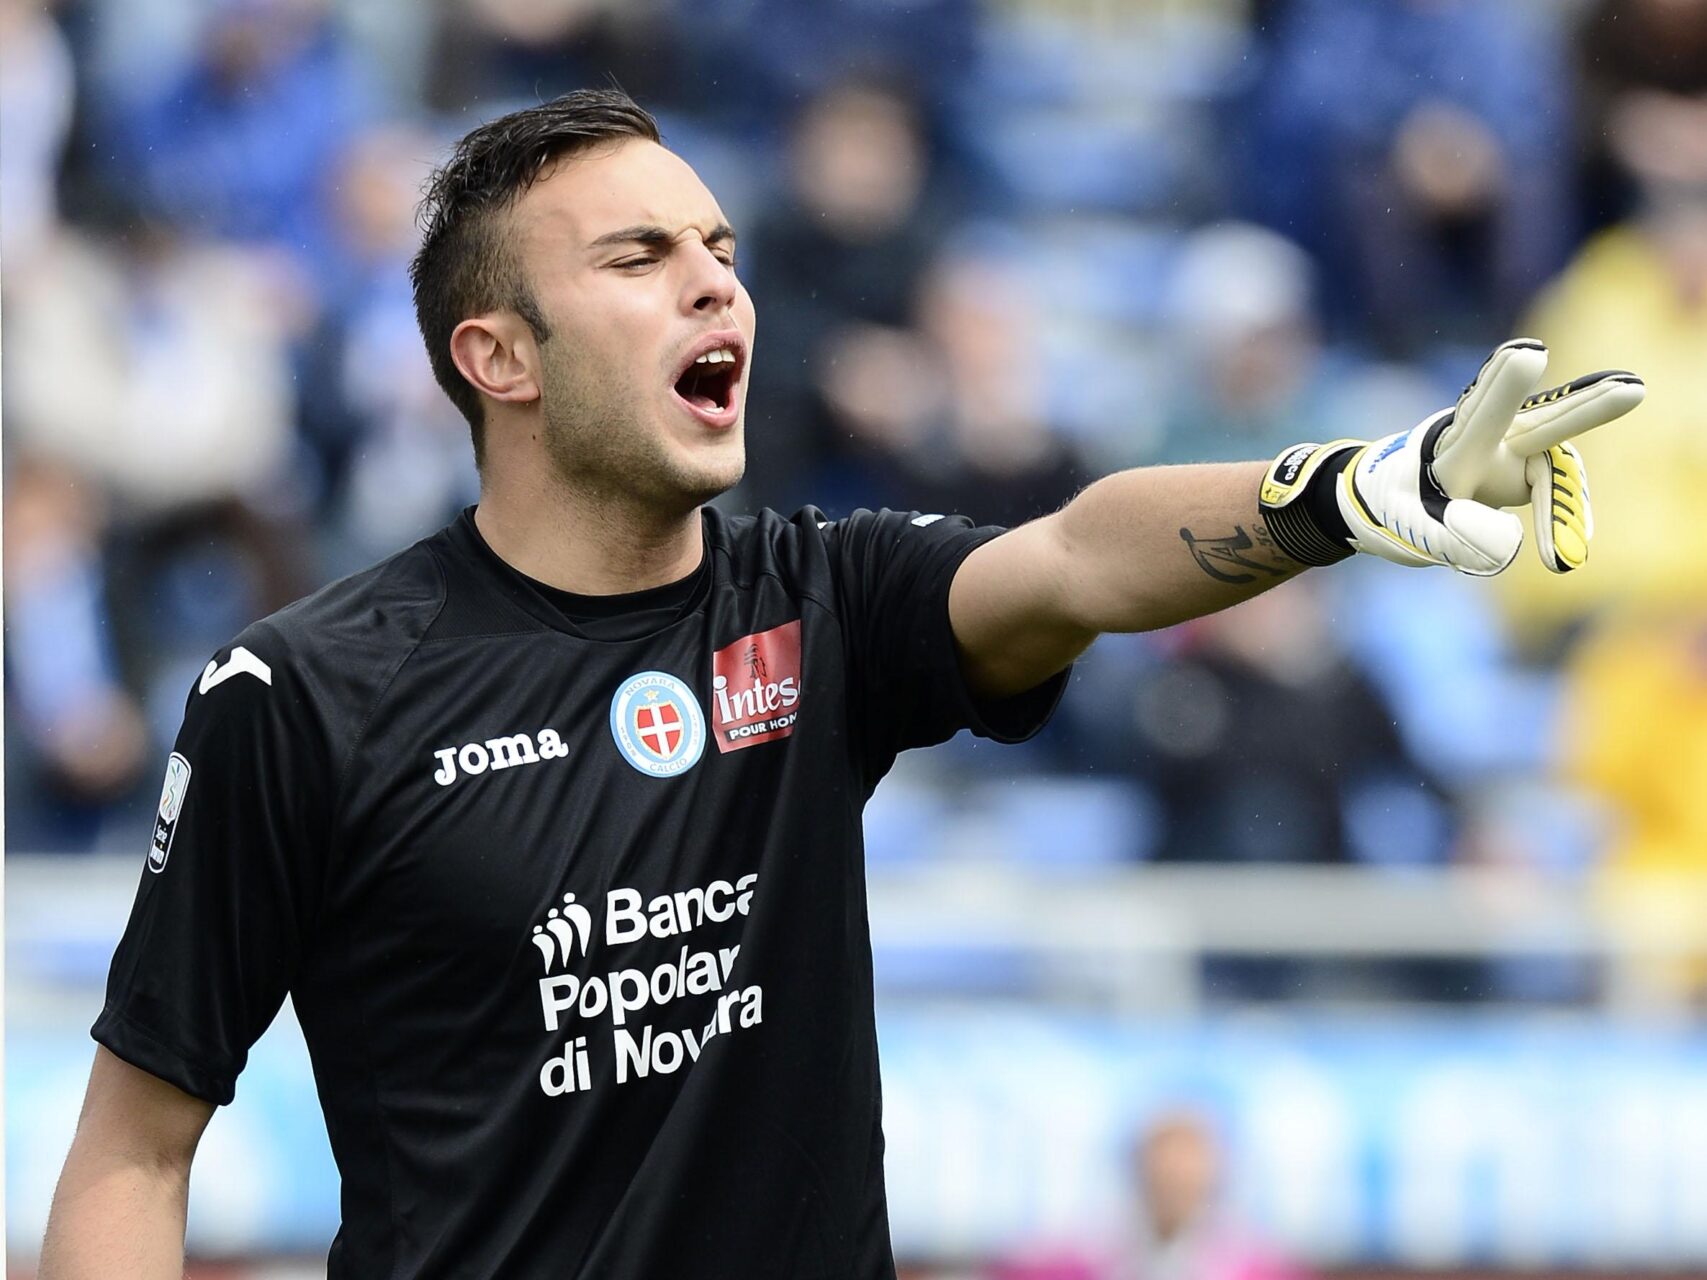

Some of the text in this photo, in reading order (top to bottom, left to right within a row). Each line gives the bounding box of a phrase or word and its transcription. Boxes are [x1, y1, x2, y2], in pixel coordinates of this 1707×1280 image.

[625, 678, 675, 696] NOVARA
[713, 676, 800, 724] intes
[729, 722, 767, 740] POUR
[649, 758, 687, 773] CALCIO
[606, 873, 758, 945] Banca
[539, 1036, 591, 1096] di
